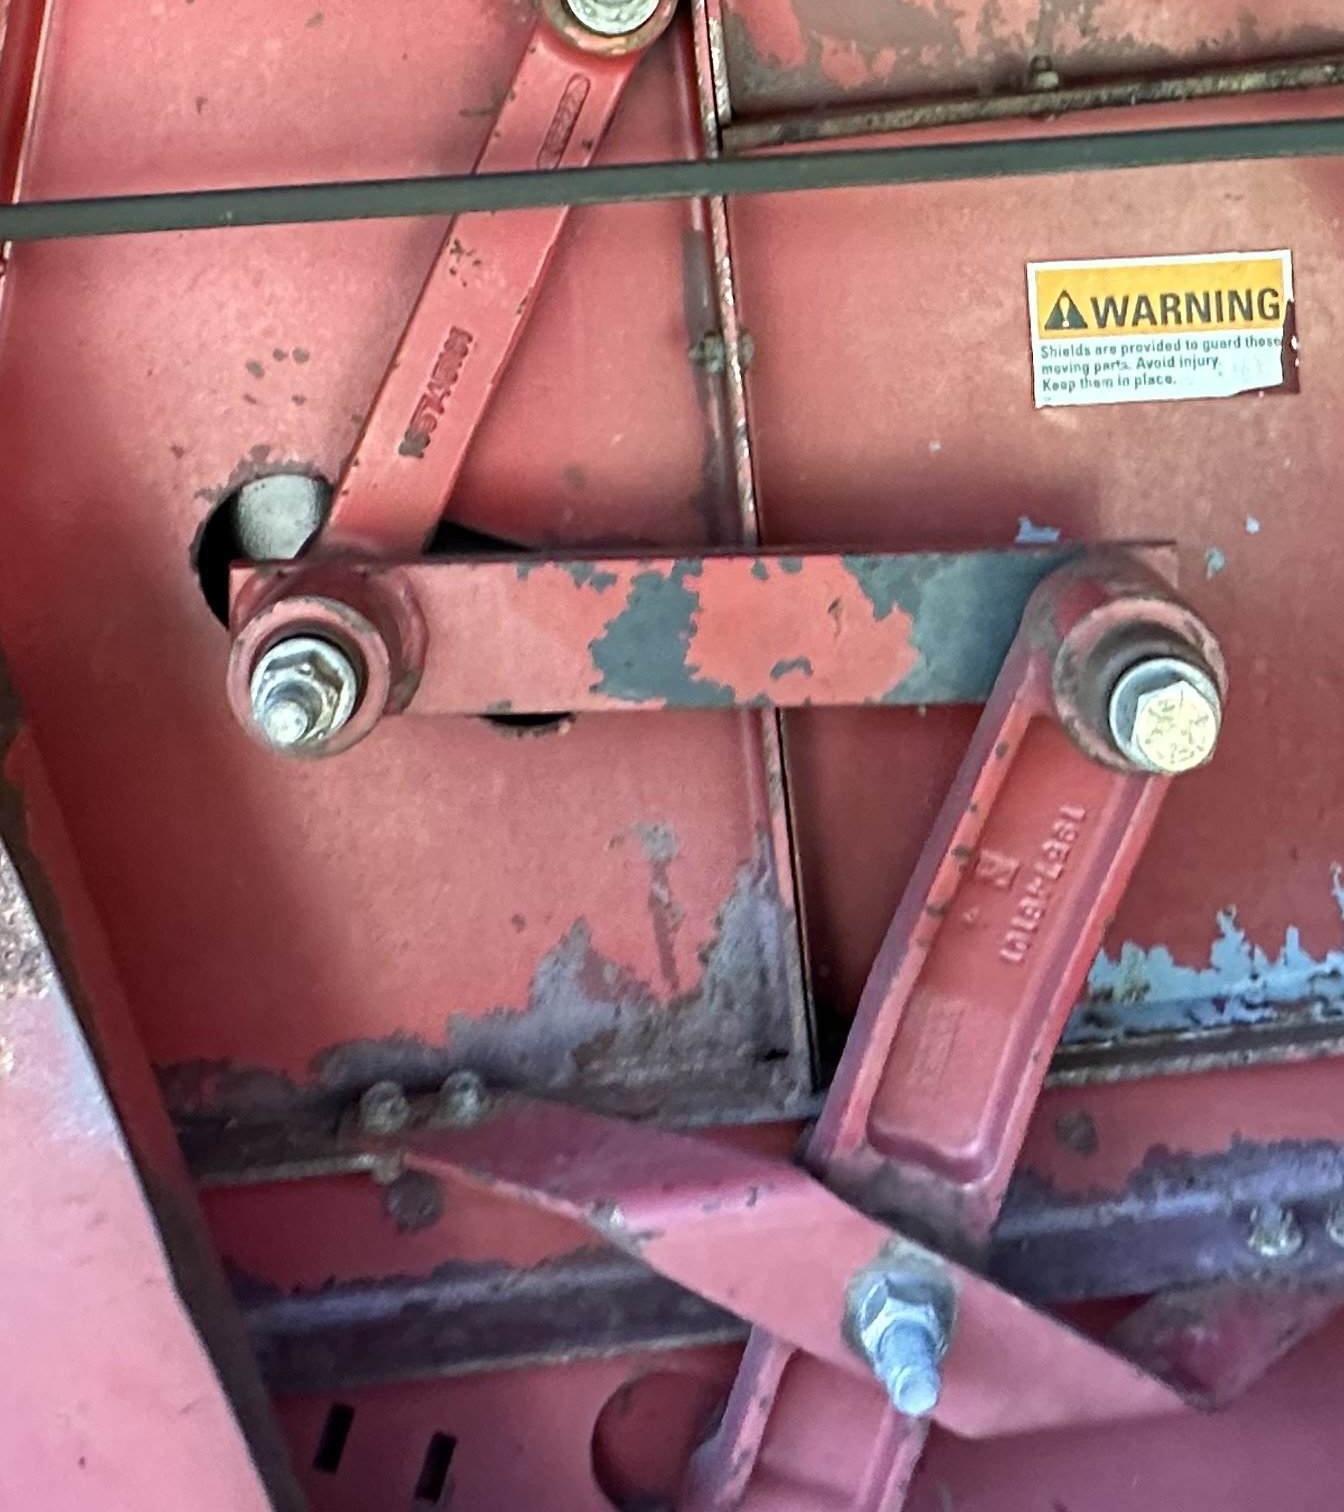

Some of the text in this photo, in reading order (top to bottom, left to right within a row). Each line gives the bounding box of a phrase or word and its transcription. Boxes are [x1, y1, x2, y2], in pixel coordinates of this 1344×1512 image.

[1090, 288, 1280, 329] WARNING
[1040, 343, 1091, 359] Shields
[1095, 345, 1118, 356] are
[1121, 338, 1181, 358] provided
[1185, 338, 1199, 351] to
[1203, 334, 1241, 353] guard
[1041, 360, 1090, 376] moving
[1136, 355, 1175, 370] Avoid
[1042, 372, 1177, 394] Keep them in place.
